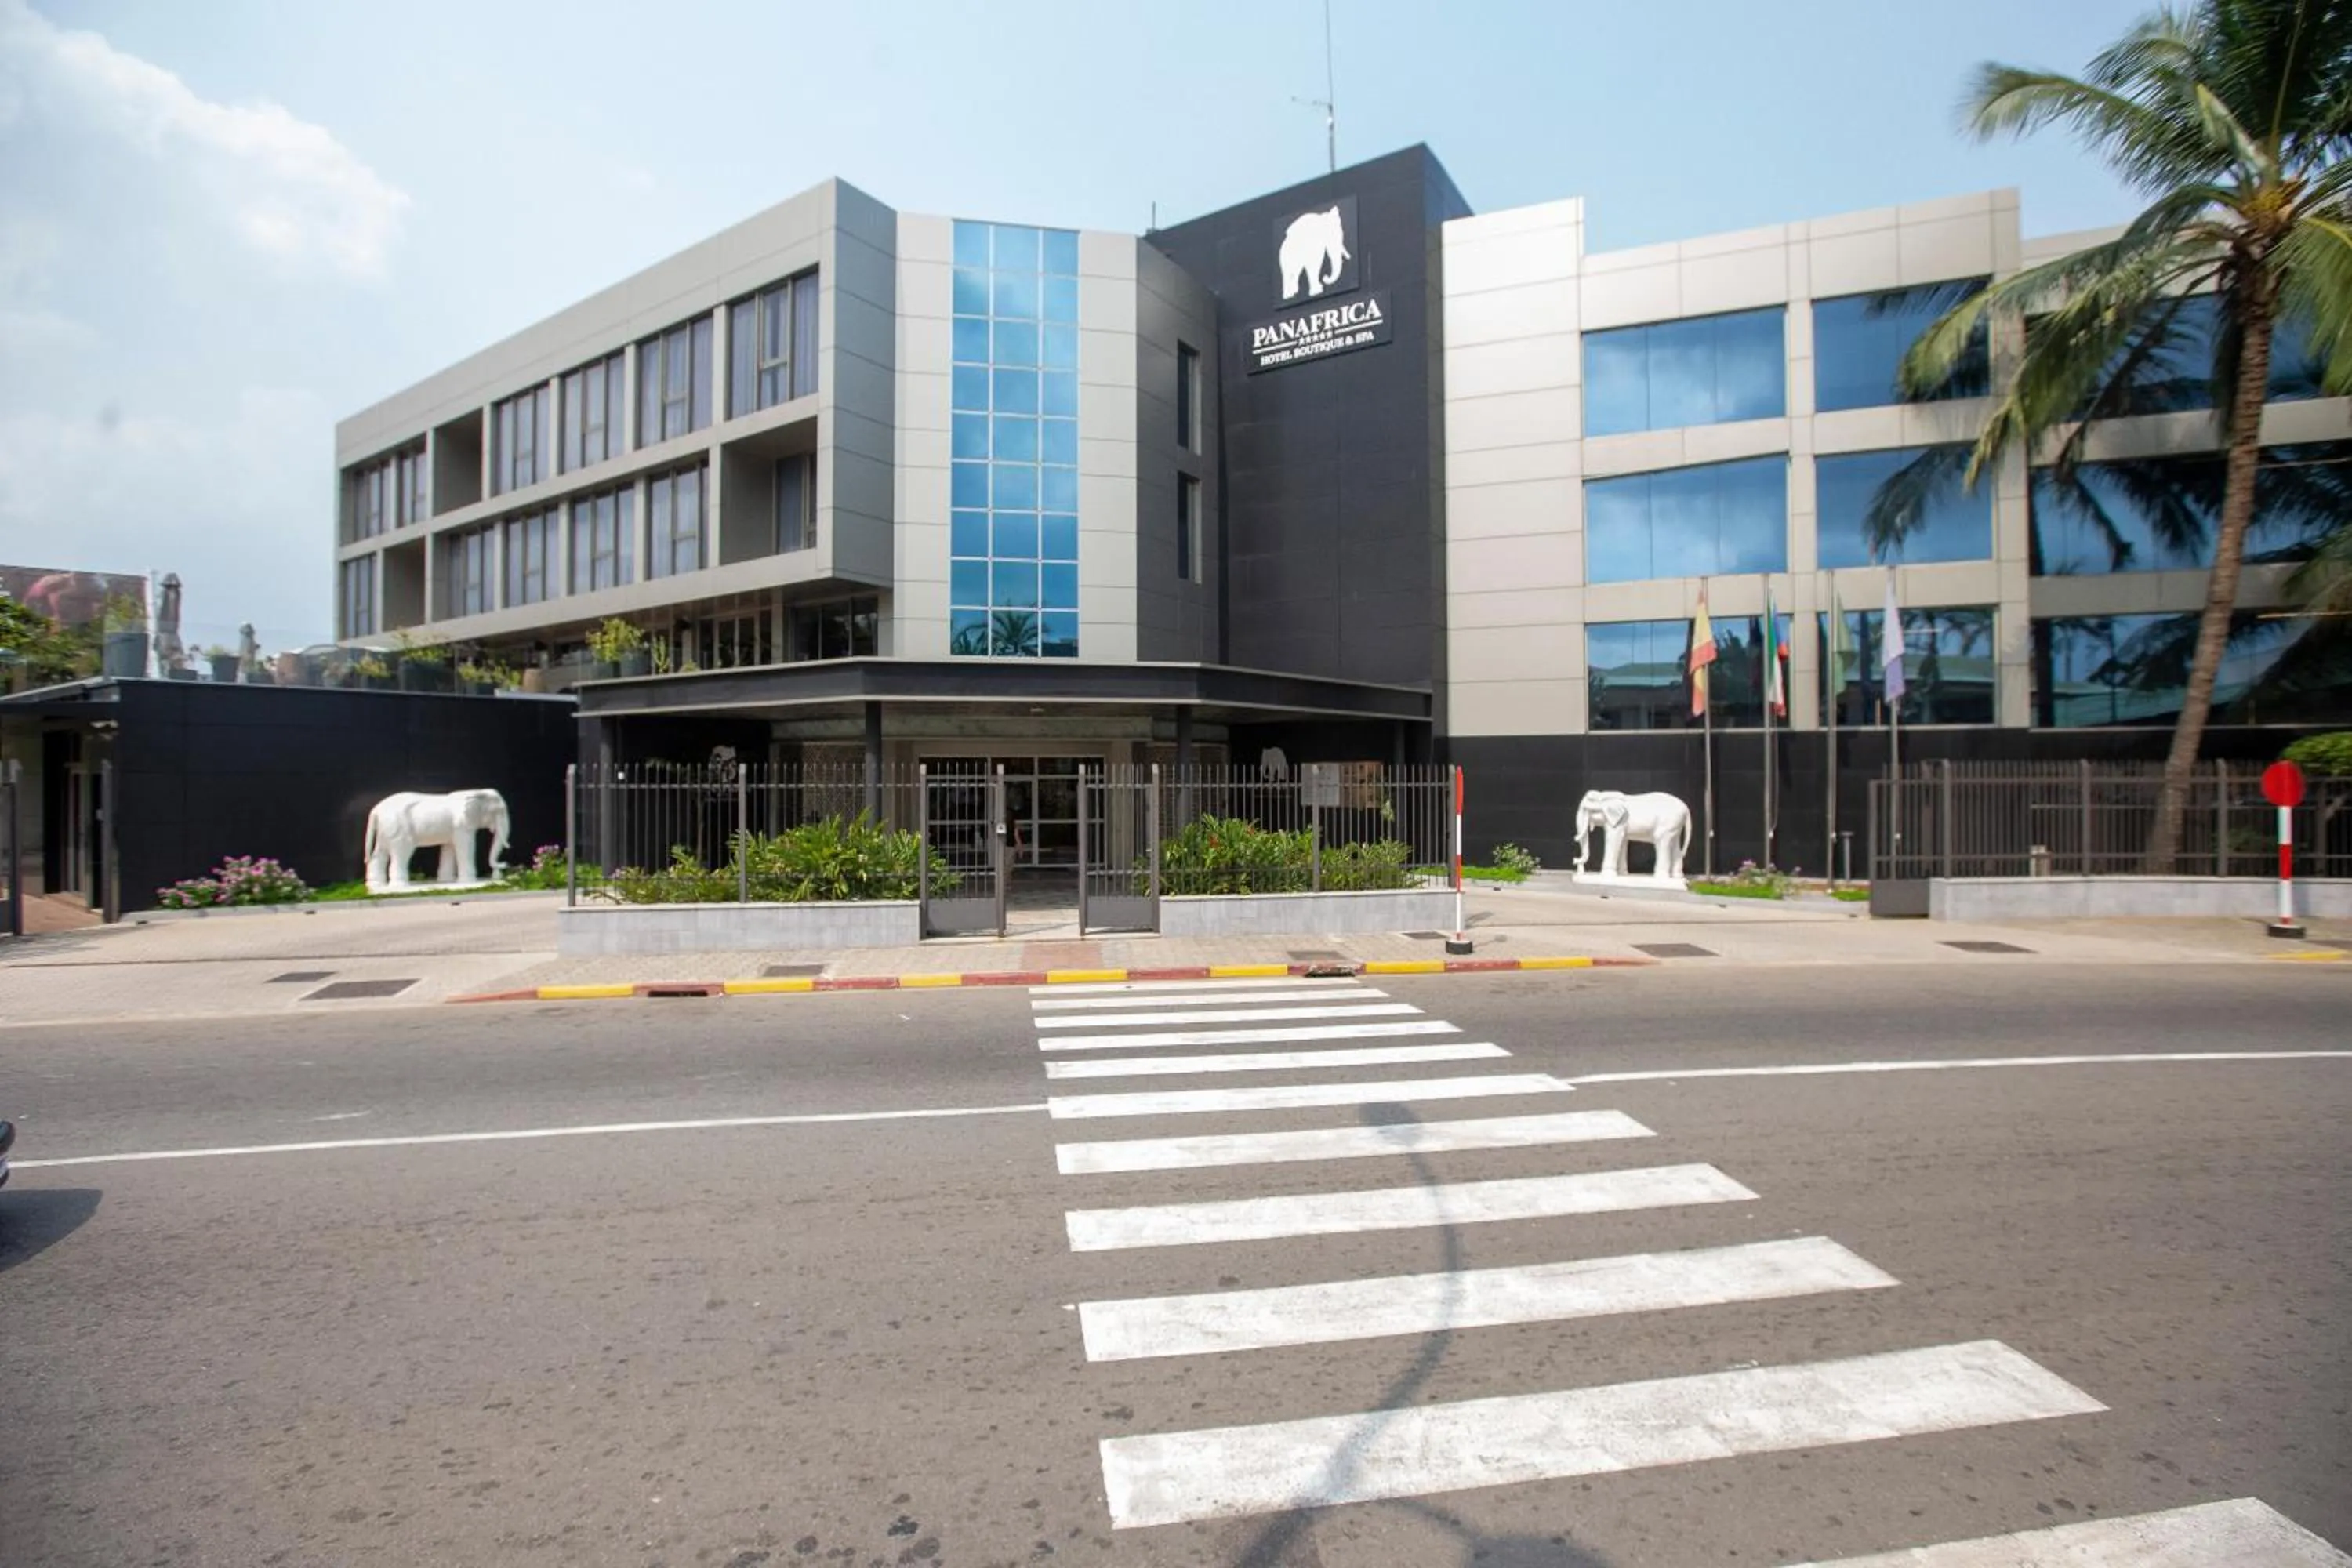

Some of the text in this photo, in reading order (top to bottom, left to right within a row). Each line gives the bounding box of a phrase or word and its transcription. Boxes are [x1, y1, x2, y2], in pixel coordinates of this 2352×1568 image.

[1252, 299, 1382, 348] PANAFRICA
[1261, 329, 1374, 366] HOTEL BOUTIQUE & SPA
